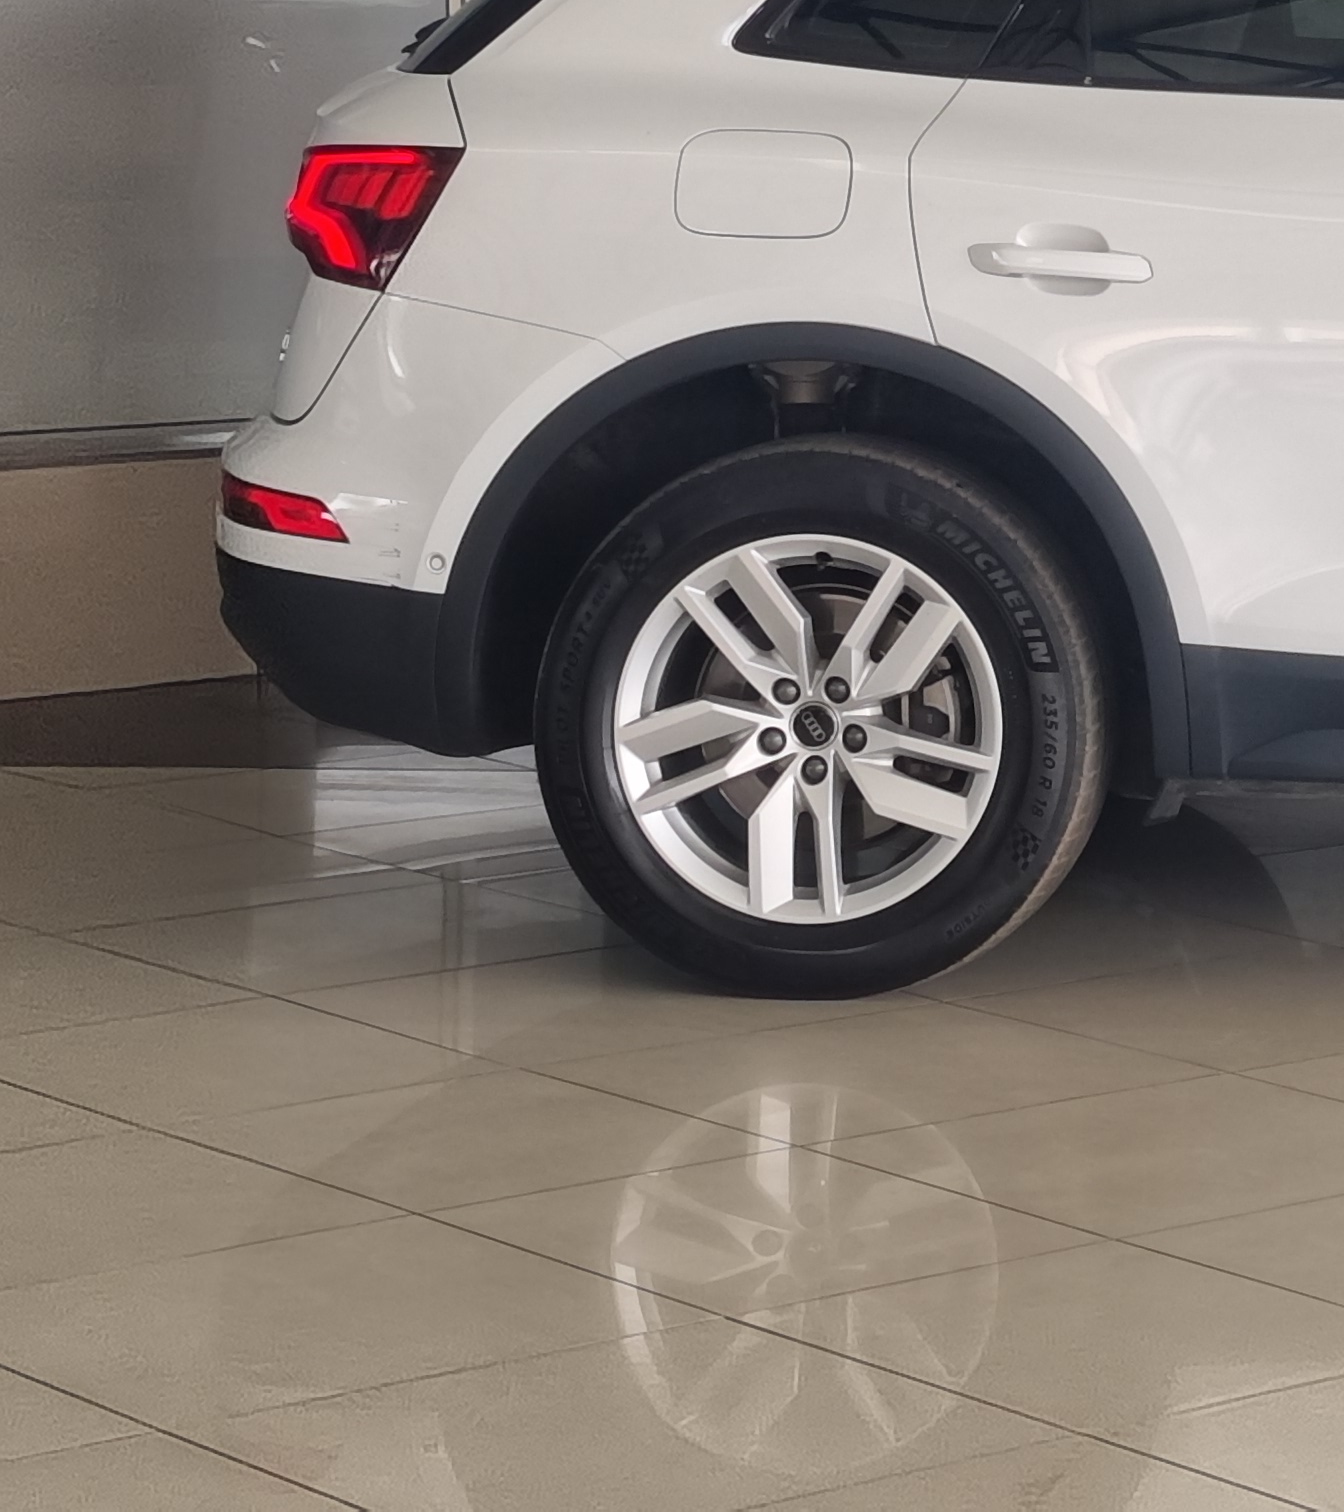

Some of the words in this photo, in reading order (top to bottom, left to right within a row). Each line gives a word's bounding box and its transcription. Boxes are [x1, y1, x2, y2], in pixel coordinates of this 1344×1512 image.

[935, 516, 1051, 665] MICHELIN
[1040, 694, 1058, 770] 235/60
[1036, 774, 1053, 790] R
[1029, 796, 1047, 819] 18
